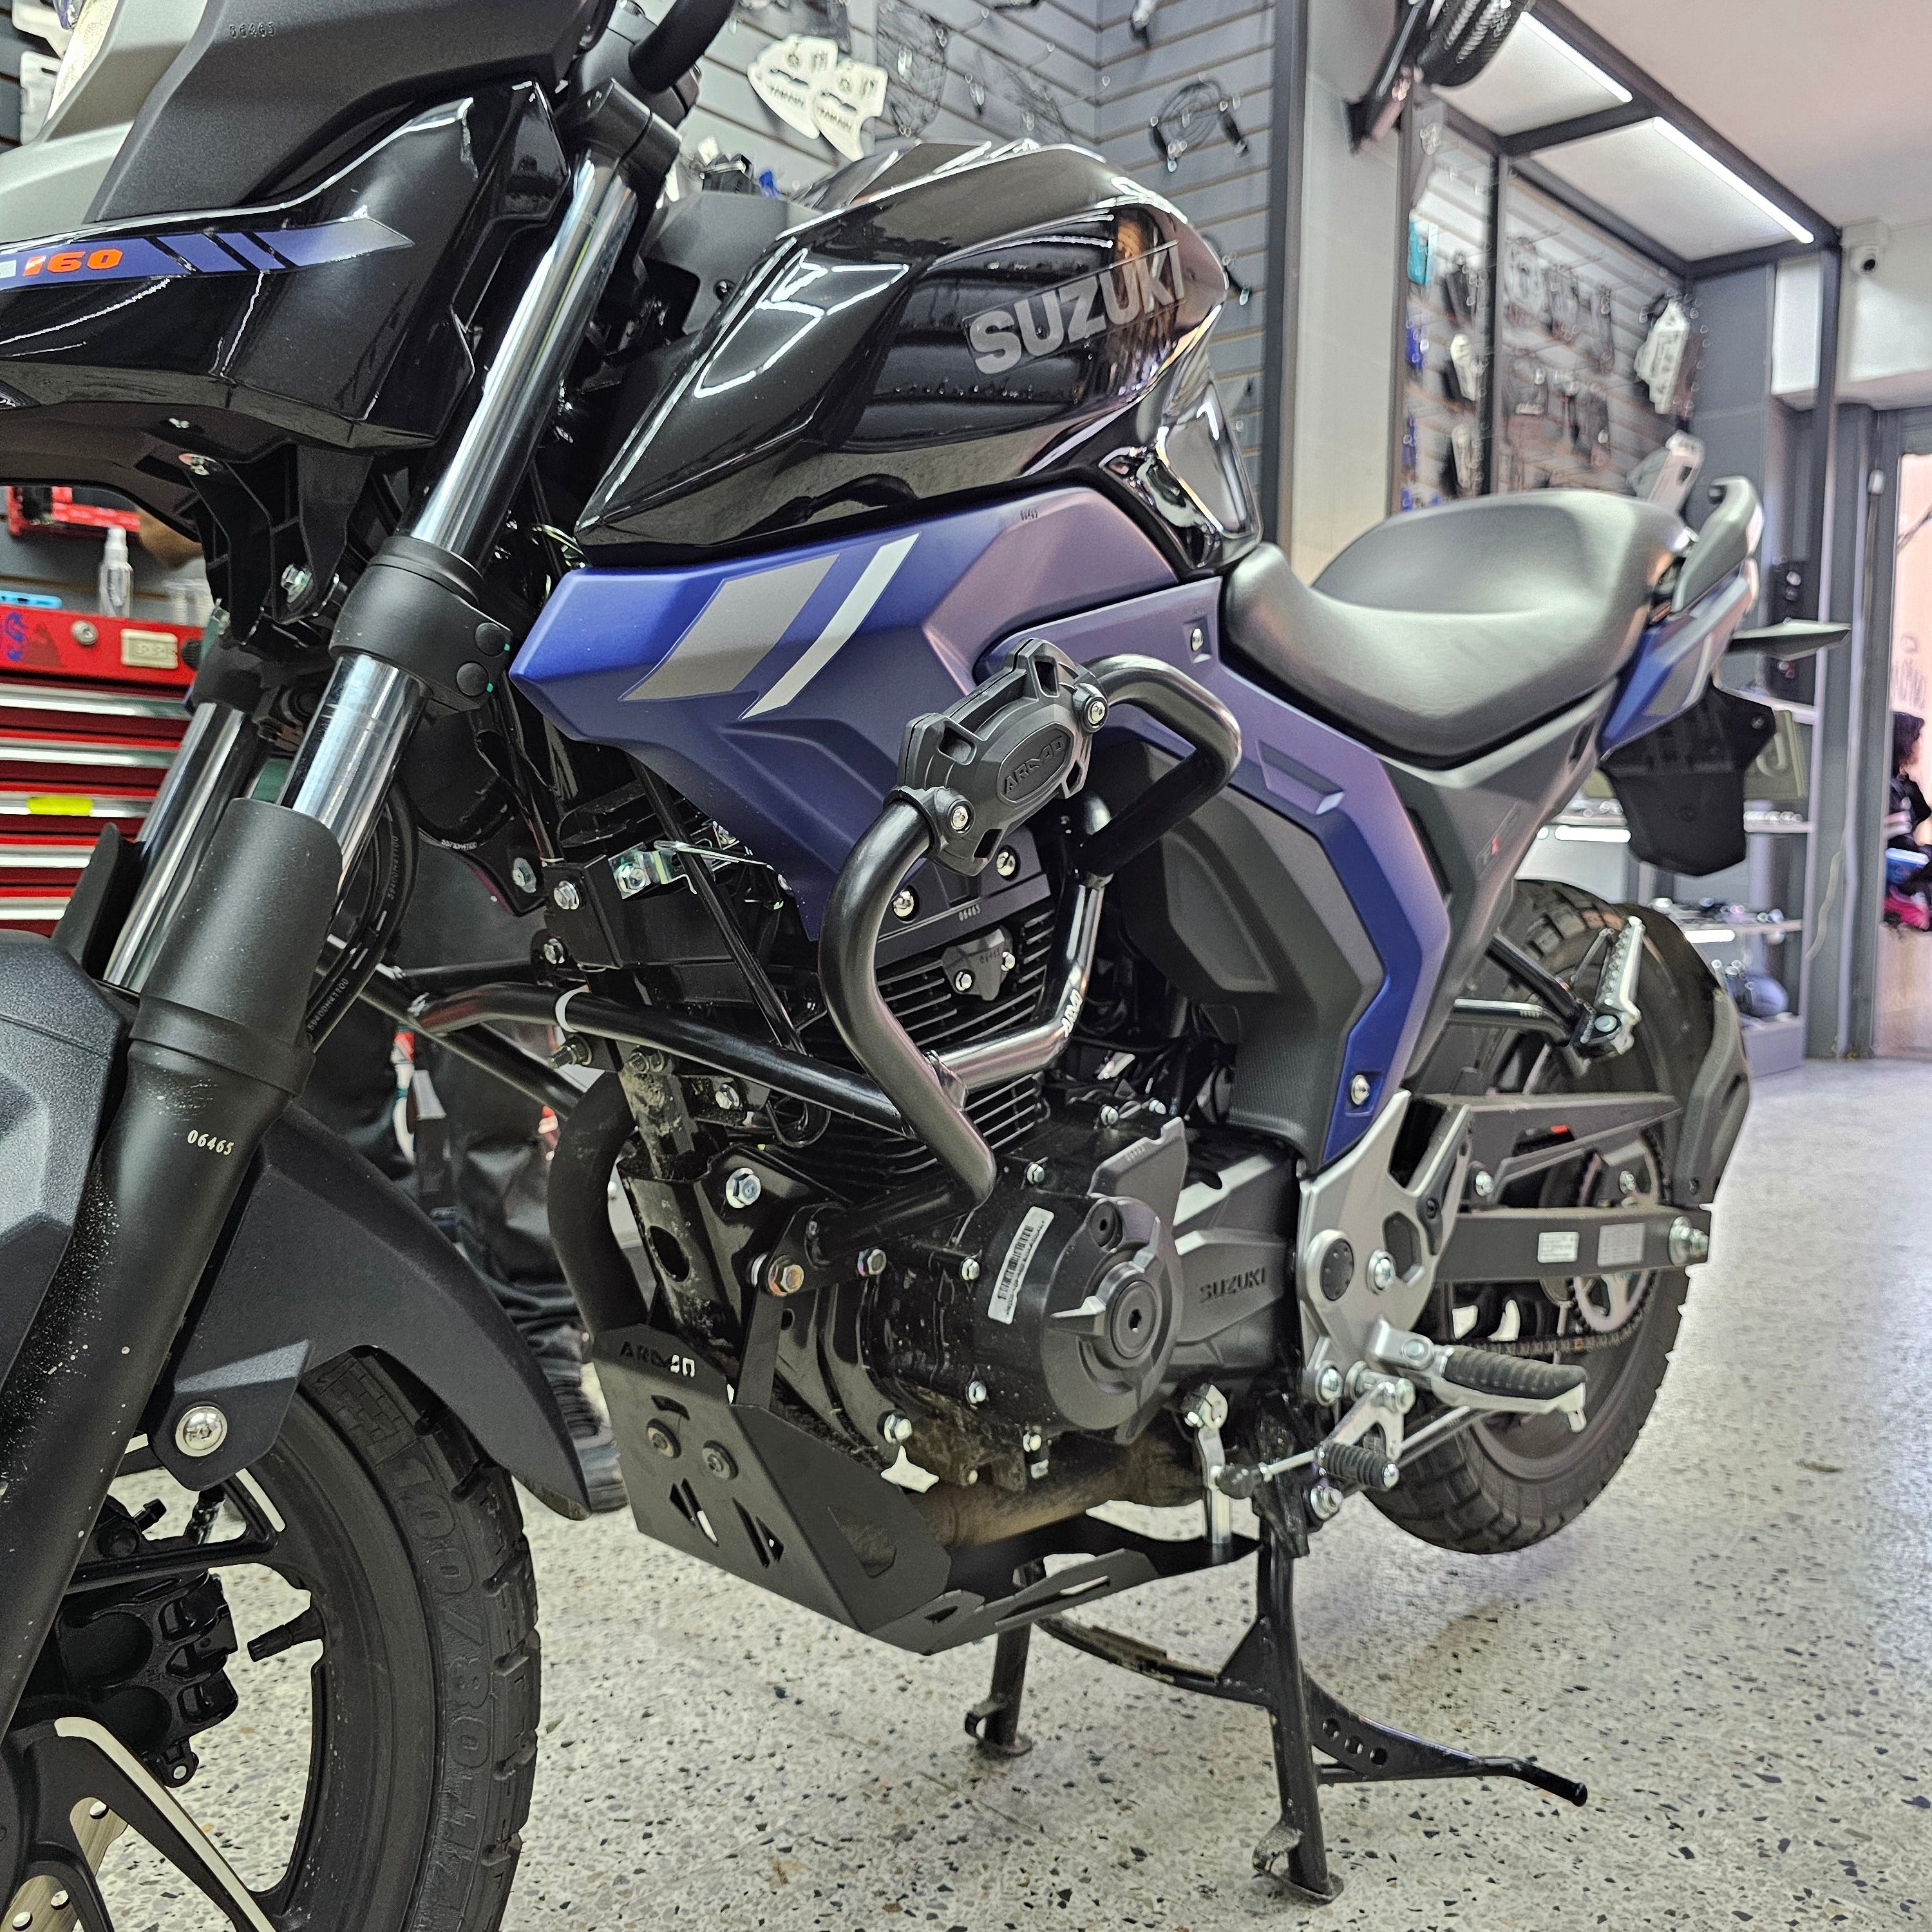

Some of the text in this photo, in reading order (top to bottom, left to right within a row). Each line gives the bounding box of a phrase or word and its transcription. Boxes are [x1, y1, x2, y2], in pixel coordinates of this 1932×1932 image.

[23, 248, 124, 277] 160
[969, 245, 1184, 374] SUZUKI
[187, 1130, 234, 1155] 06465
[1199, 1267, 1265, 1303] SUZUKI
